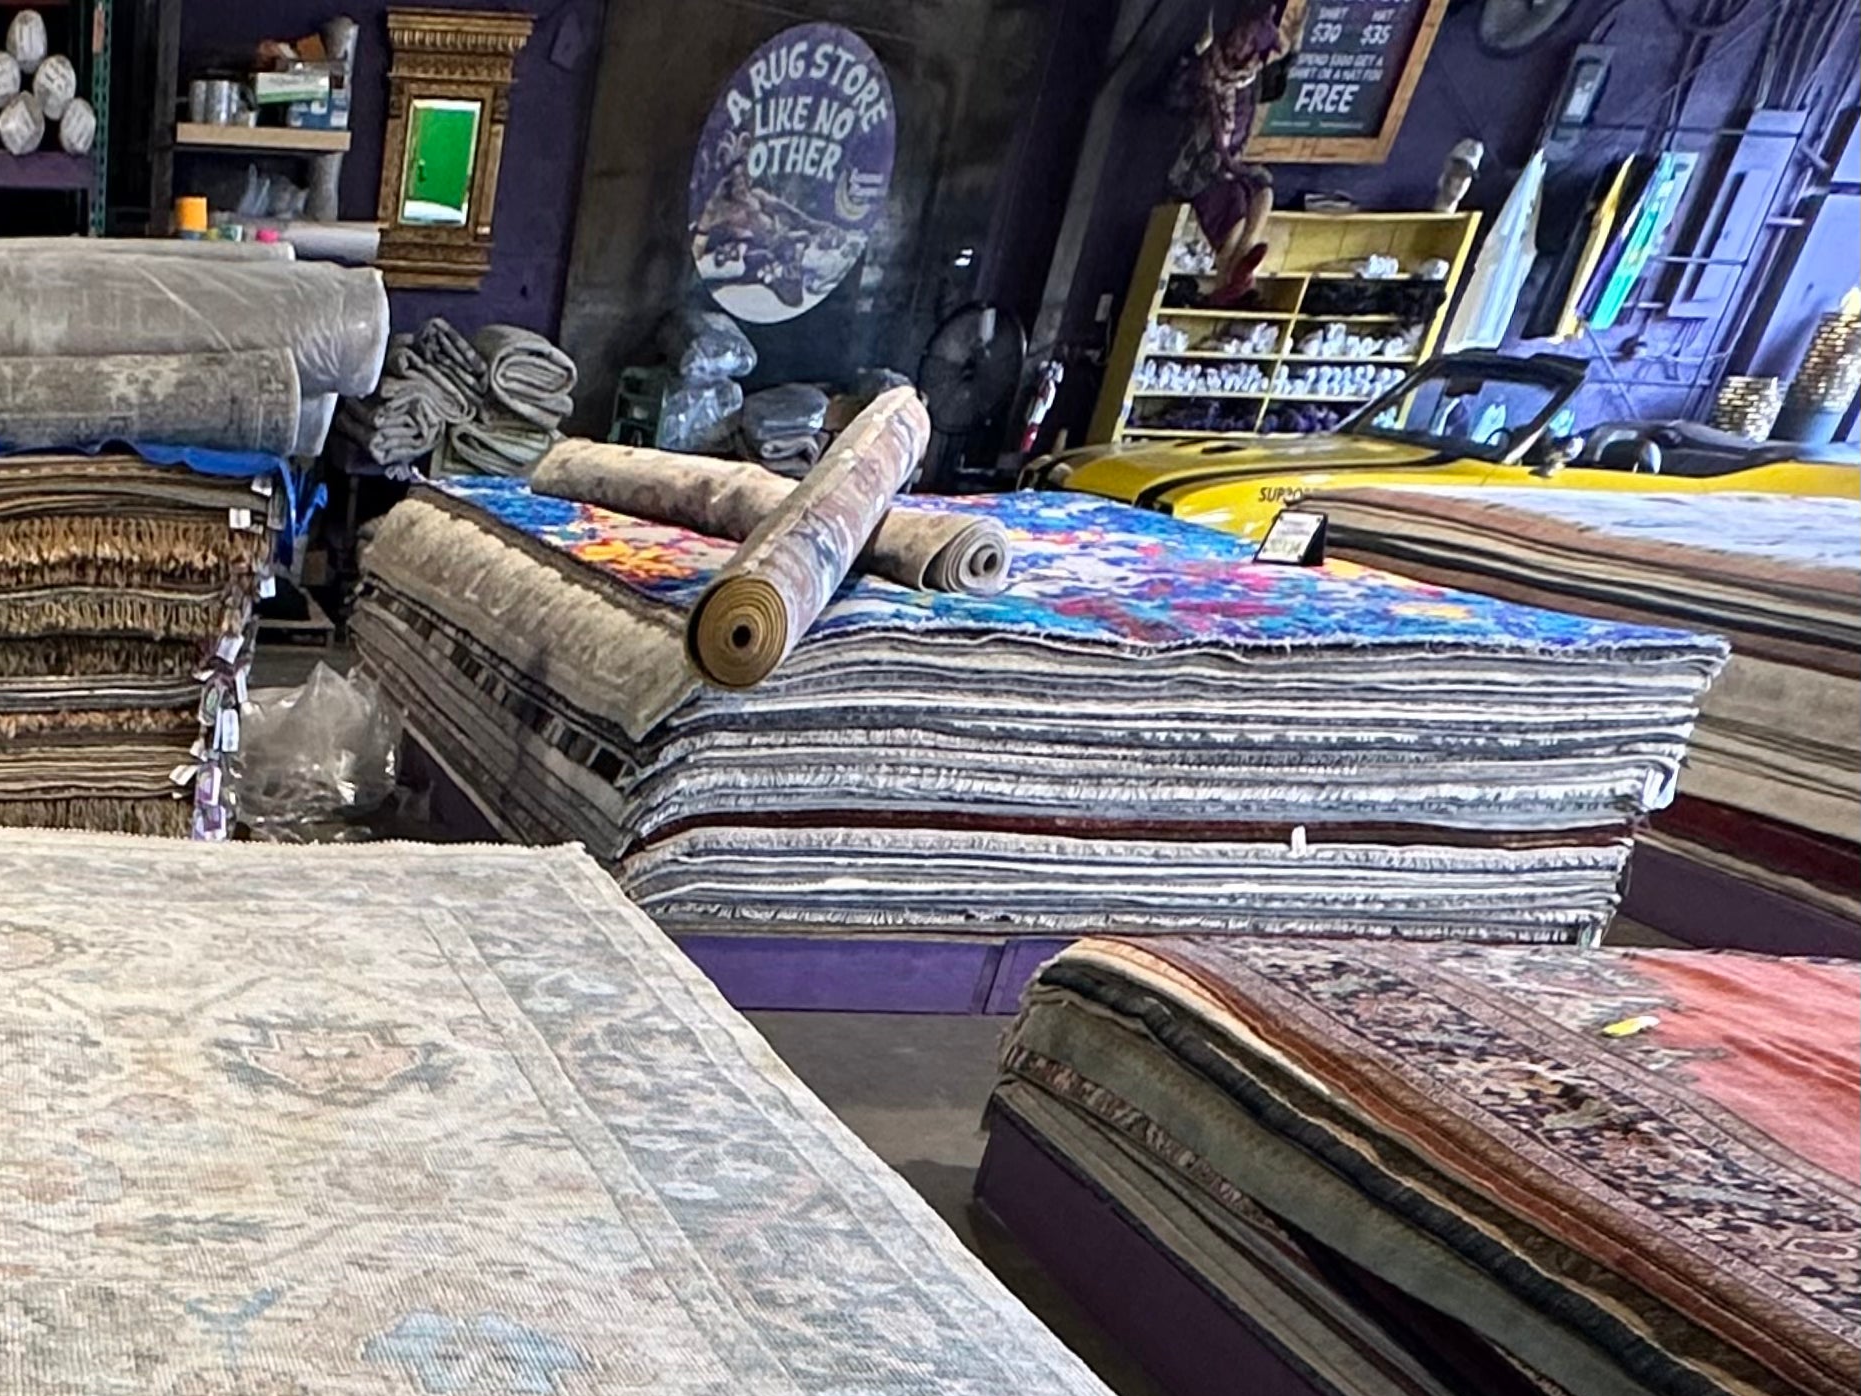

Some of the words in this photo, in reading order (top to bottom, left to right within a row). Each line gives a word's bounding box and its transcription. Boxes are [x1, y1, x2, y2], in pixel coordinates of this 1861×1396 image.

[1310, 23, 1343, 44] $30
[1360, 24, 1393, 46] $35
[1333, 69, 1341, 79] A
[1376, 55, 1384, 66] A
[725, 89, 752, 127] A
[749, 40, 809, 99] RUG
[810, 44, 887, 133] STORE
[1294, 83, 1360, 113] FREE
[754, 95, 812, 135] LIKE
[813, 97, 856, 140] NO
[748, 136, 843, 181] OTHER
